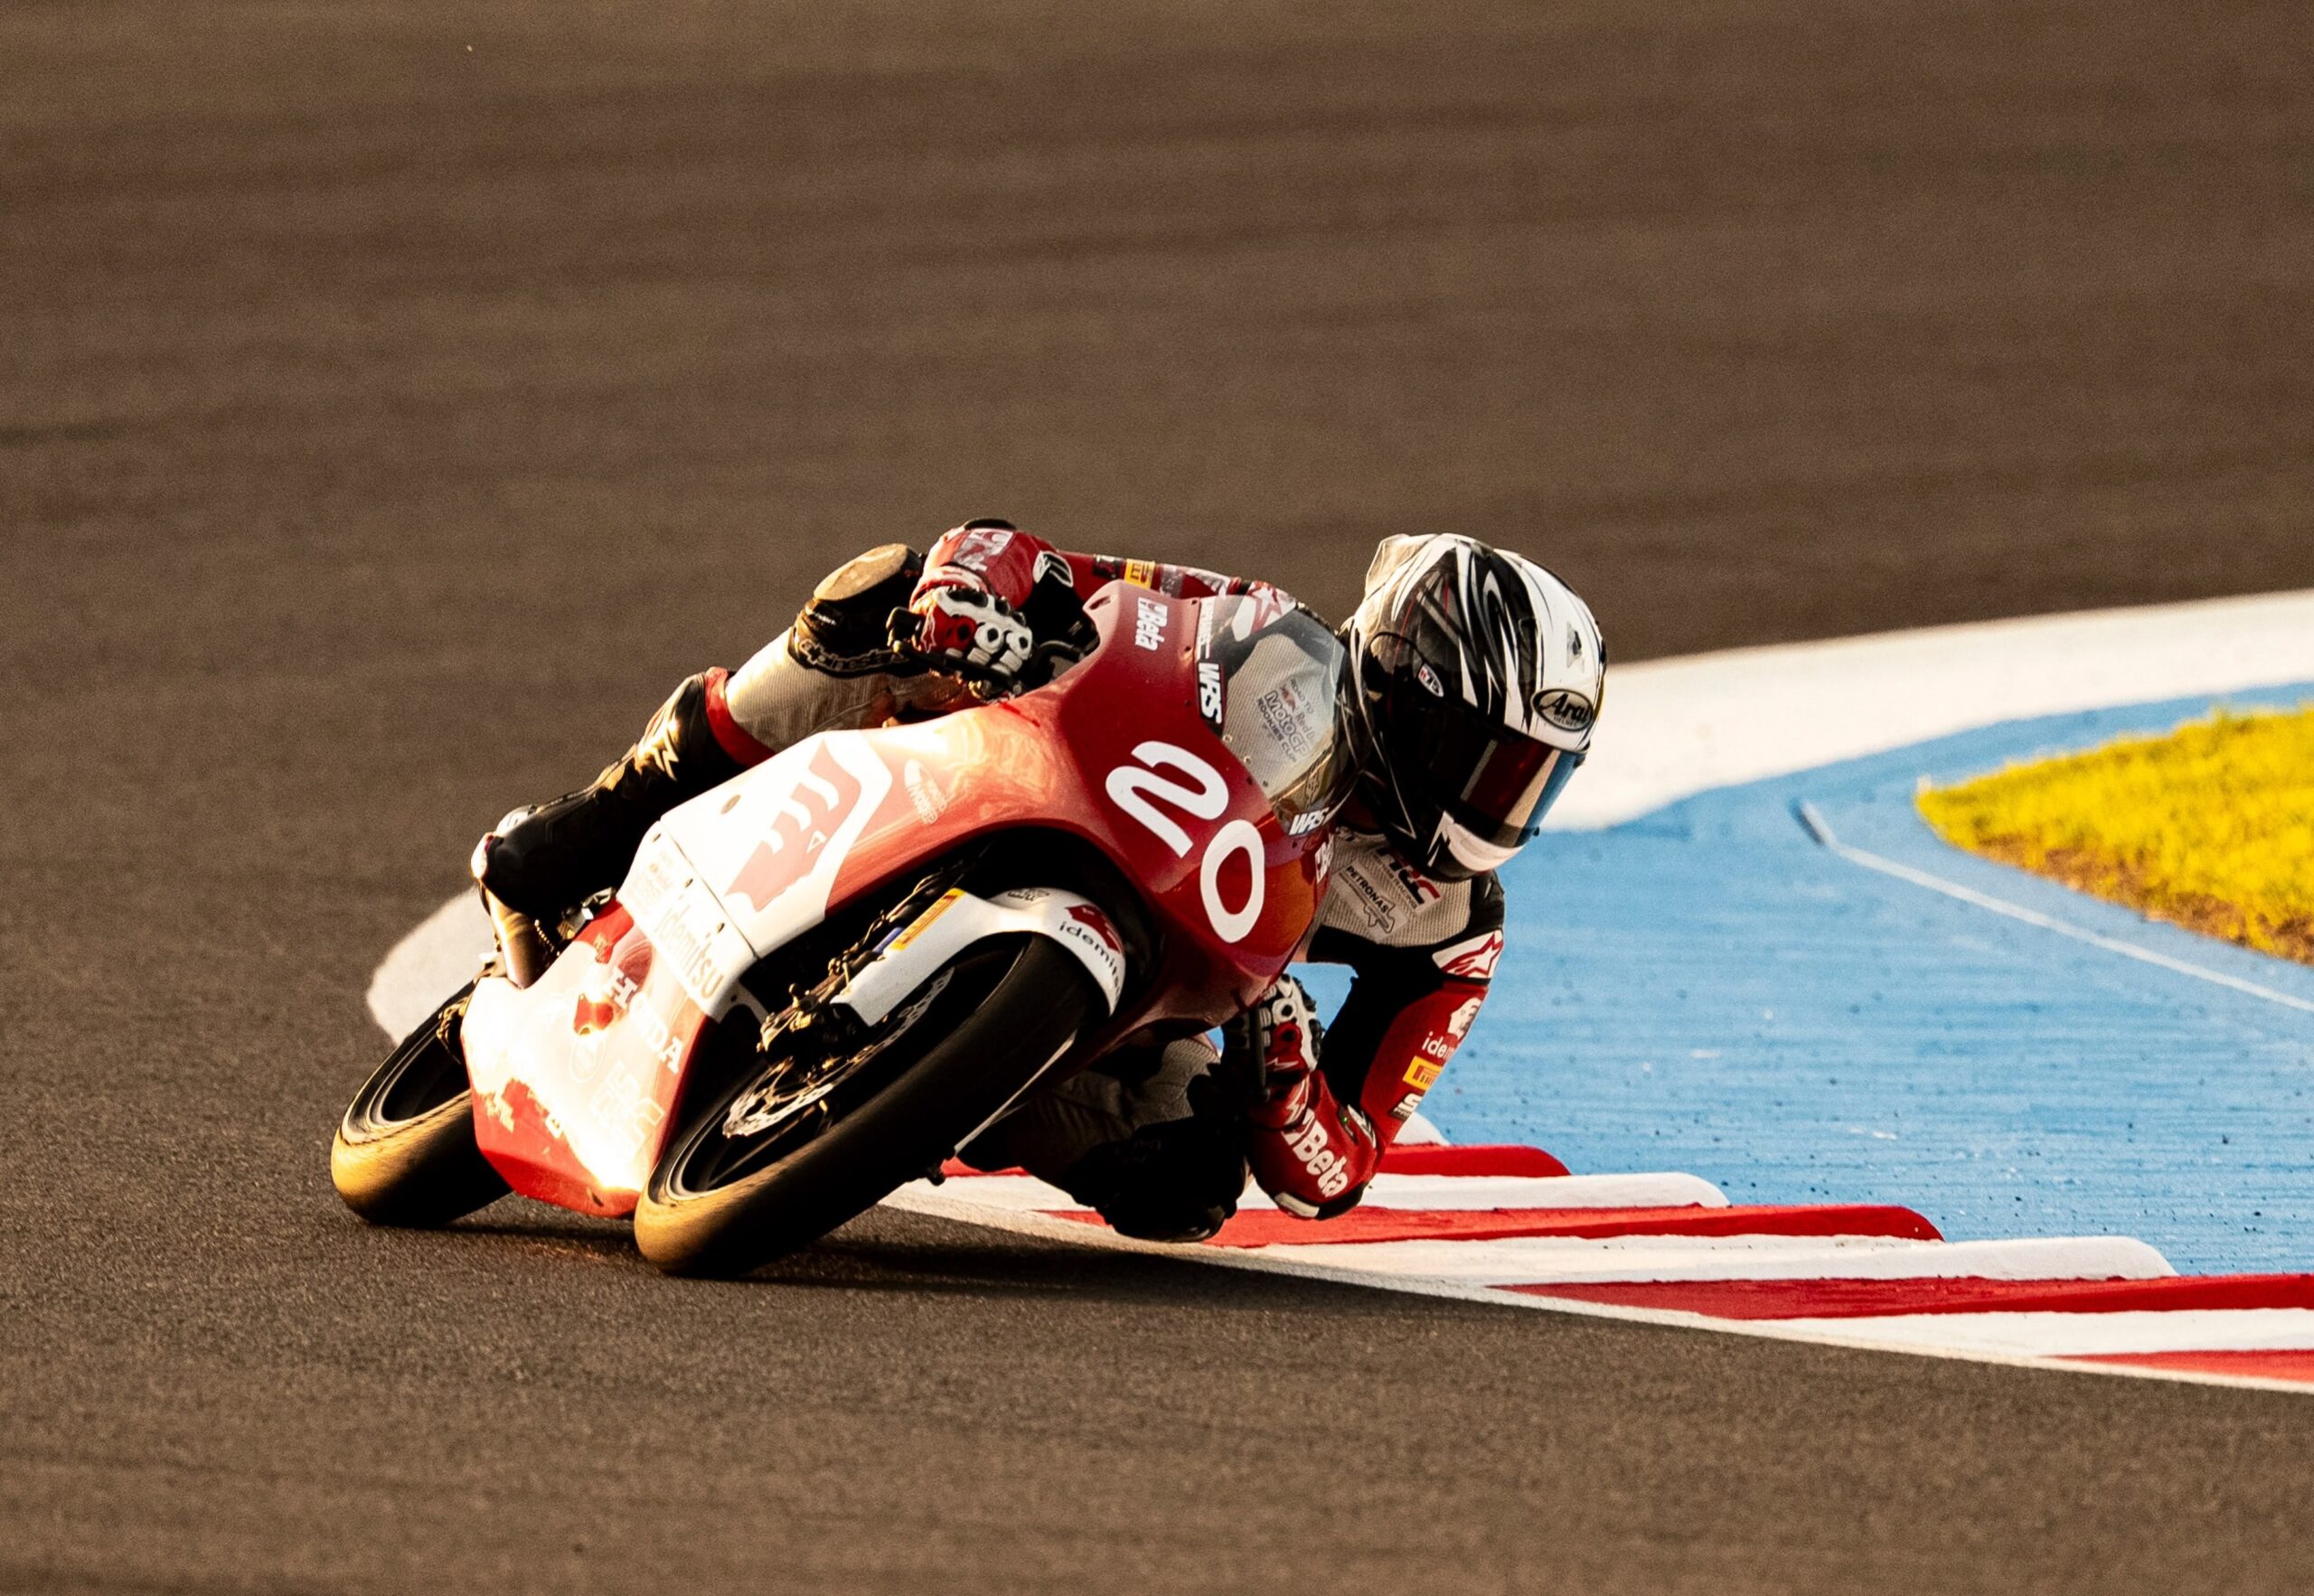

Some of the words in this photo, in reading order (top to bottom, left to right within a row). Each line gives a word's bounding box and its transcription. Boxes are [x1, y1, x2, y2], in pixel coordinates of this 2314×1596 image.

[1256, 696, 1284, 741] ROOKIES
[1265, 690, 1309, 757] MotoGP
[1105, 741, 1265, 944] 20
[1345, 866, 1389, 914] PETRONAS
[603, 966, 684, 1075] HODA
[1293, 1120, 1349, 1198] Beta
